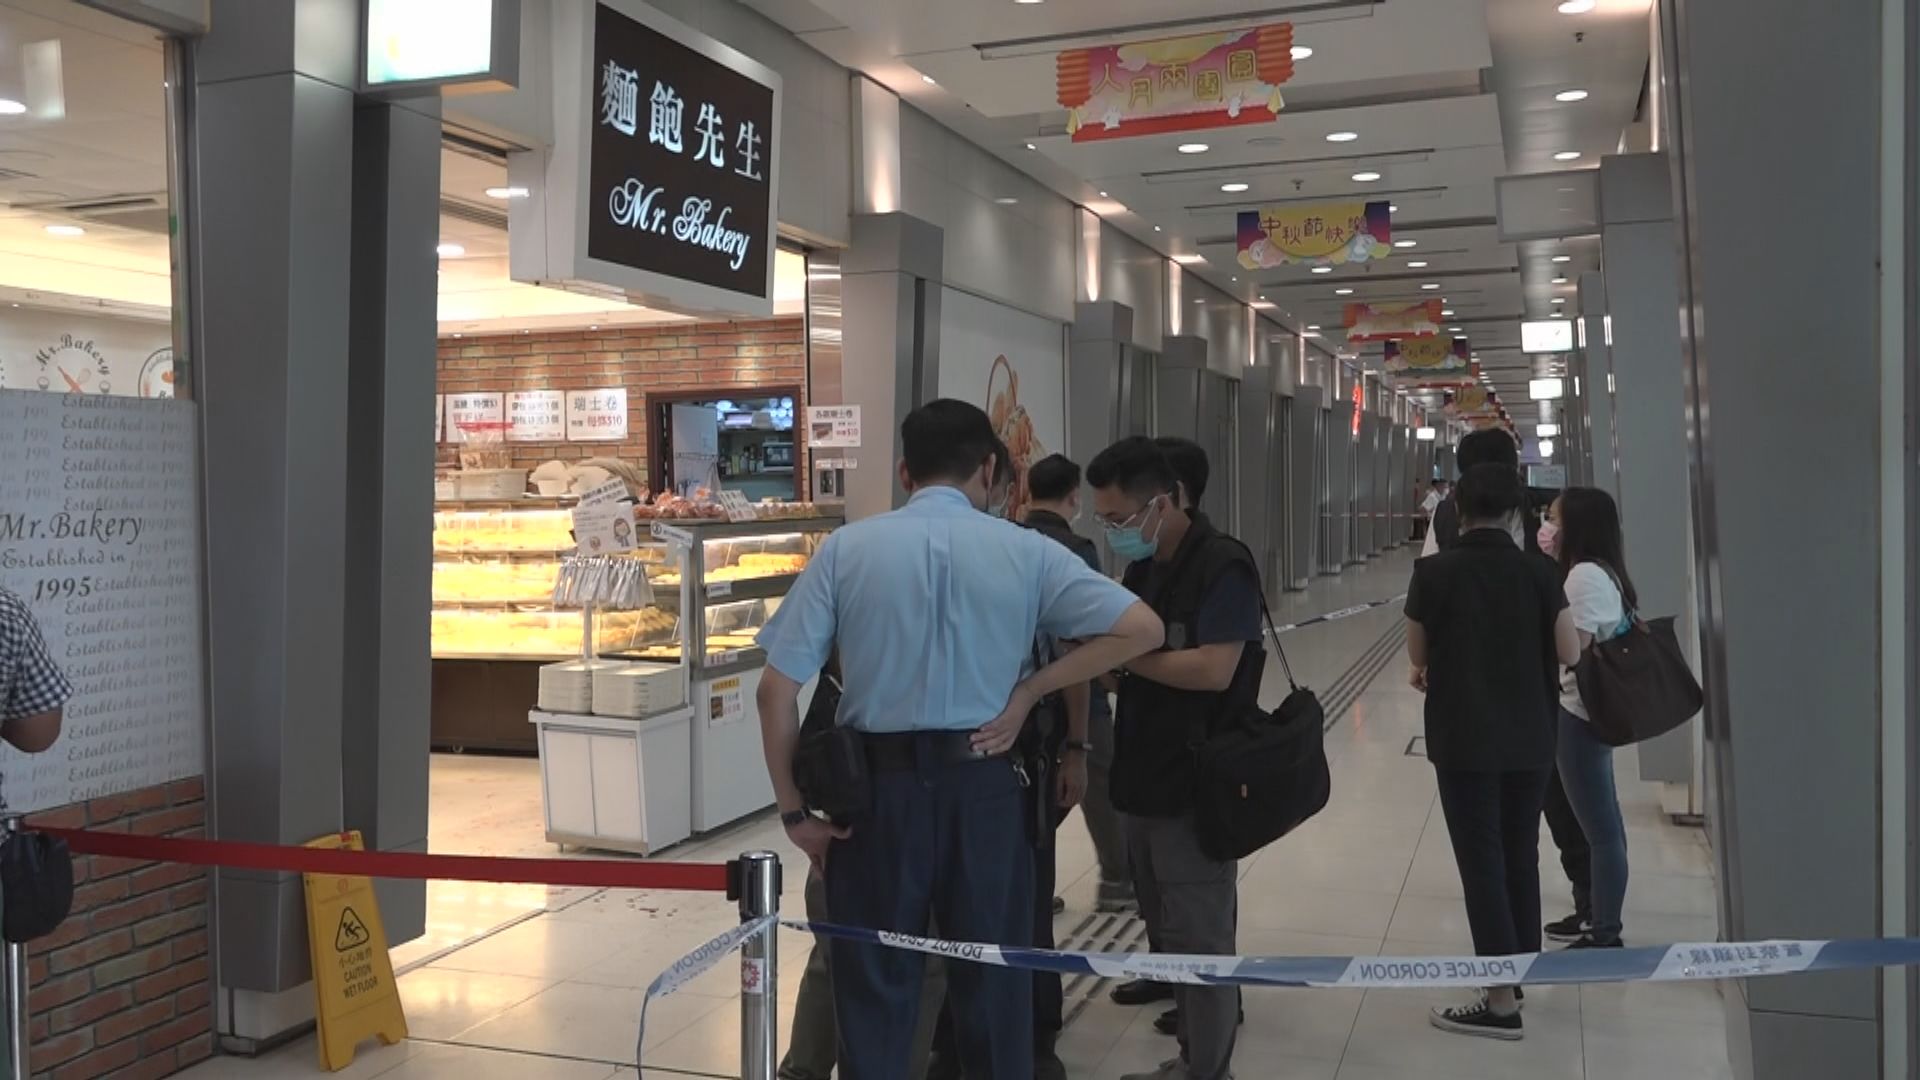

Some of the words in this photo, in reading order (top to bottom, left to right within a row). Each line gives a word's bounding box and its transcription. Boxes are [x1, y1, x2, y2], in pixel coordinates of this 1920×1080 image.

[602, 59, 762, 181] 麵飽先生
[608, 178, 666, 235] Mr.
[673, 196, 750, 270] Bakery
[1259, 215, 1368, 245] 中秋節快樂
[2, 548, 105, 570] Established
[110, 551, 127, 565] in
[35, 576, 92, 601] 1995
[343, 964, 372, 983] CAUTION
[342, 983, 357, 998] WET
[357, 976, 378, 993] FLOOR
